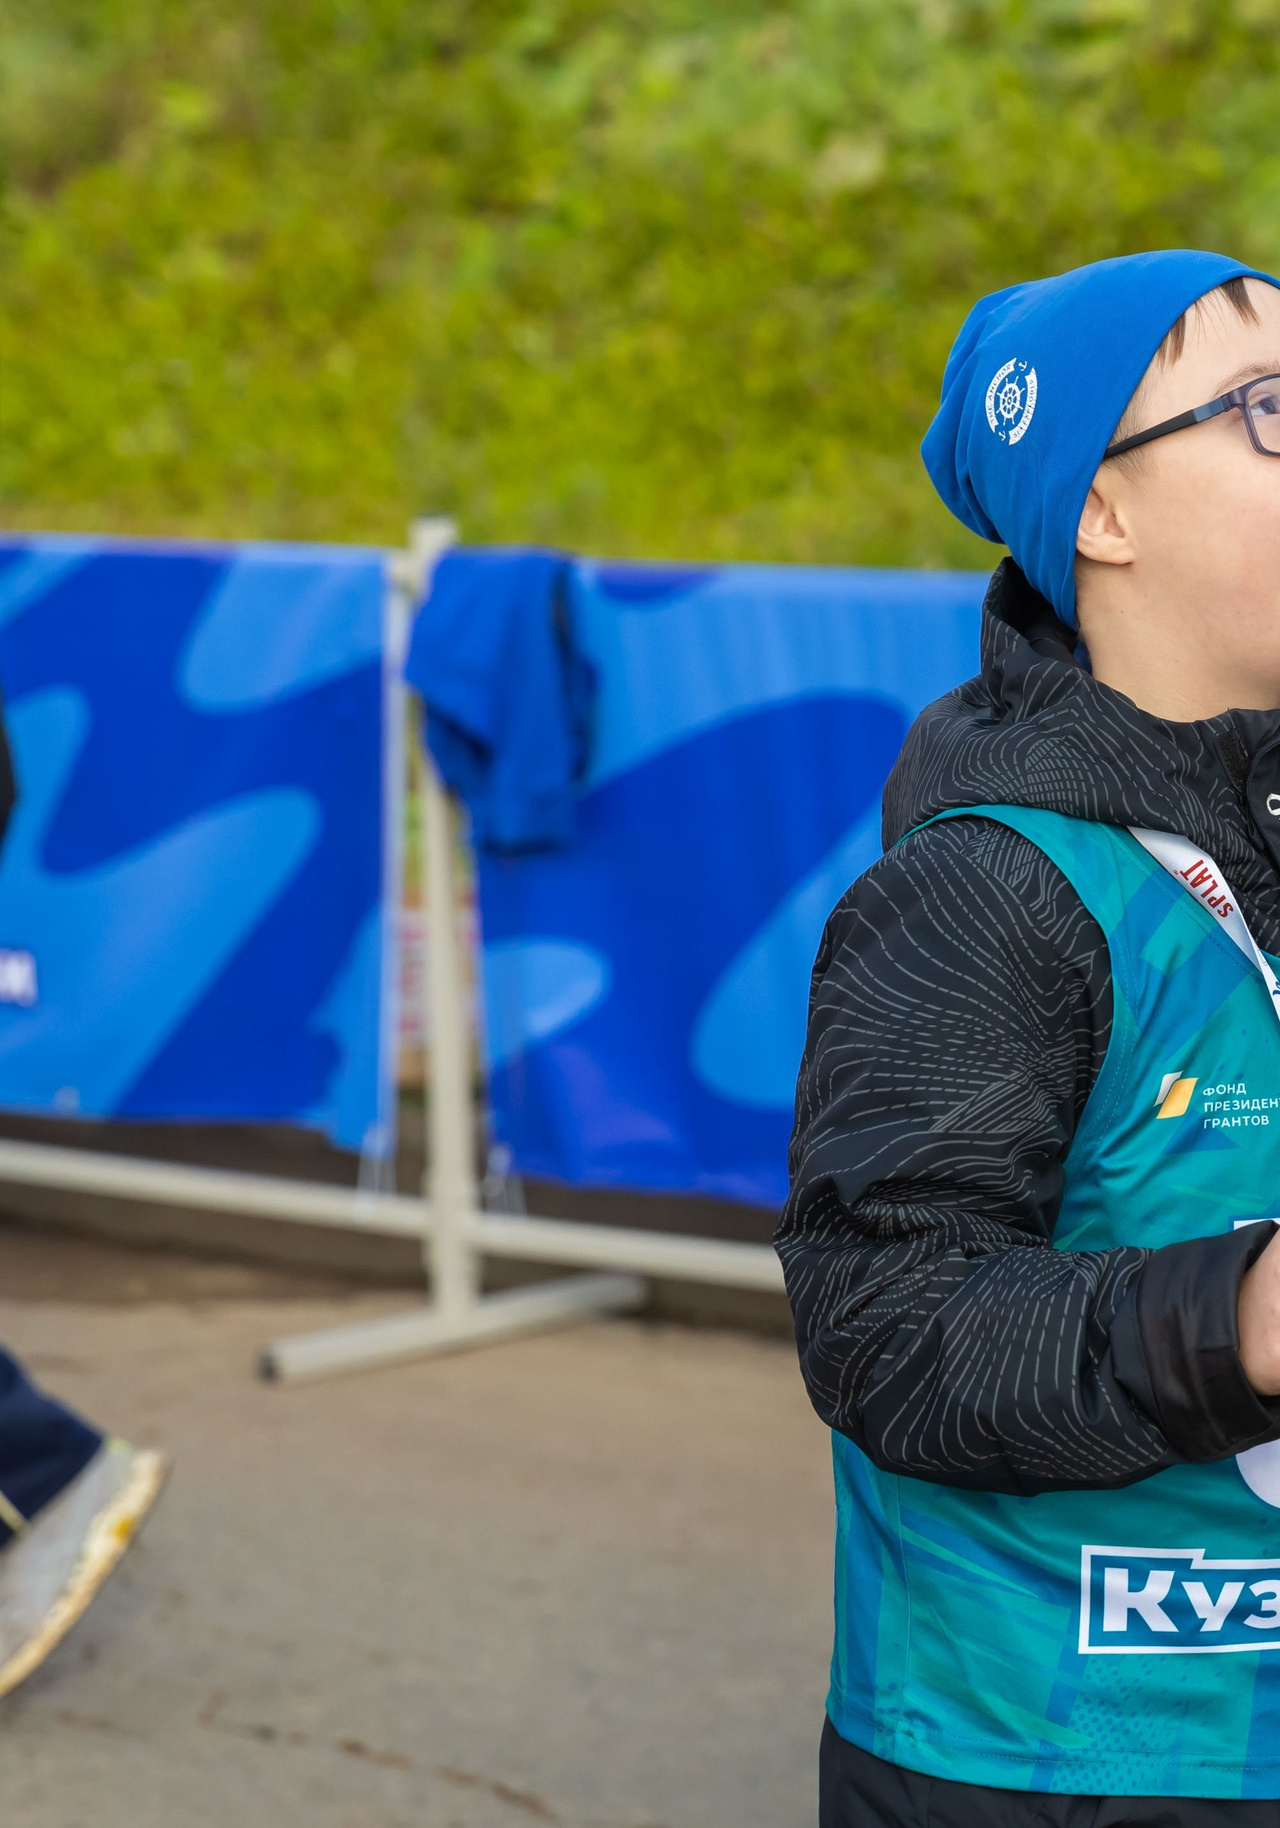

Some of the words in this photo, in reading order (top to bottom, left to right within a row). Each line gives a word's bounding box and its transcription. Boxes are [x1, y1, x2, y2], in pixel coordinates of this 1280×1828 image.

[1180, 859, 1234, 918] SPLAT
[1203, 1083, 1247, 1096] ФОНД
[1204, 1115, 1270, 1130] ГРАНТОВ
